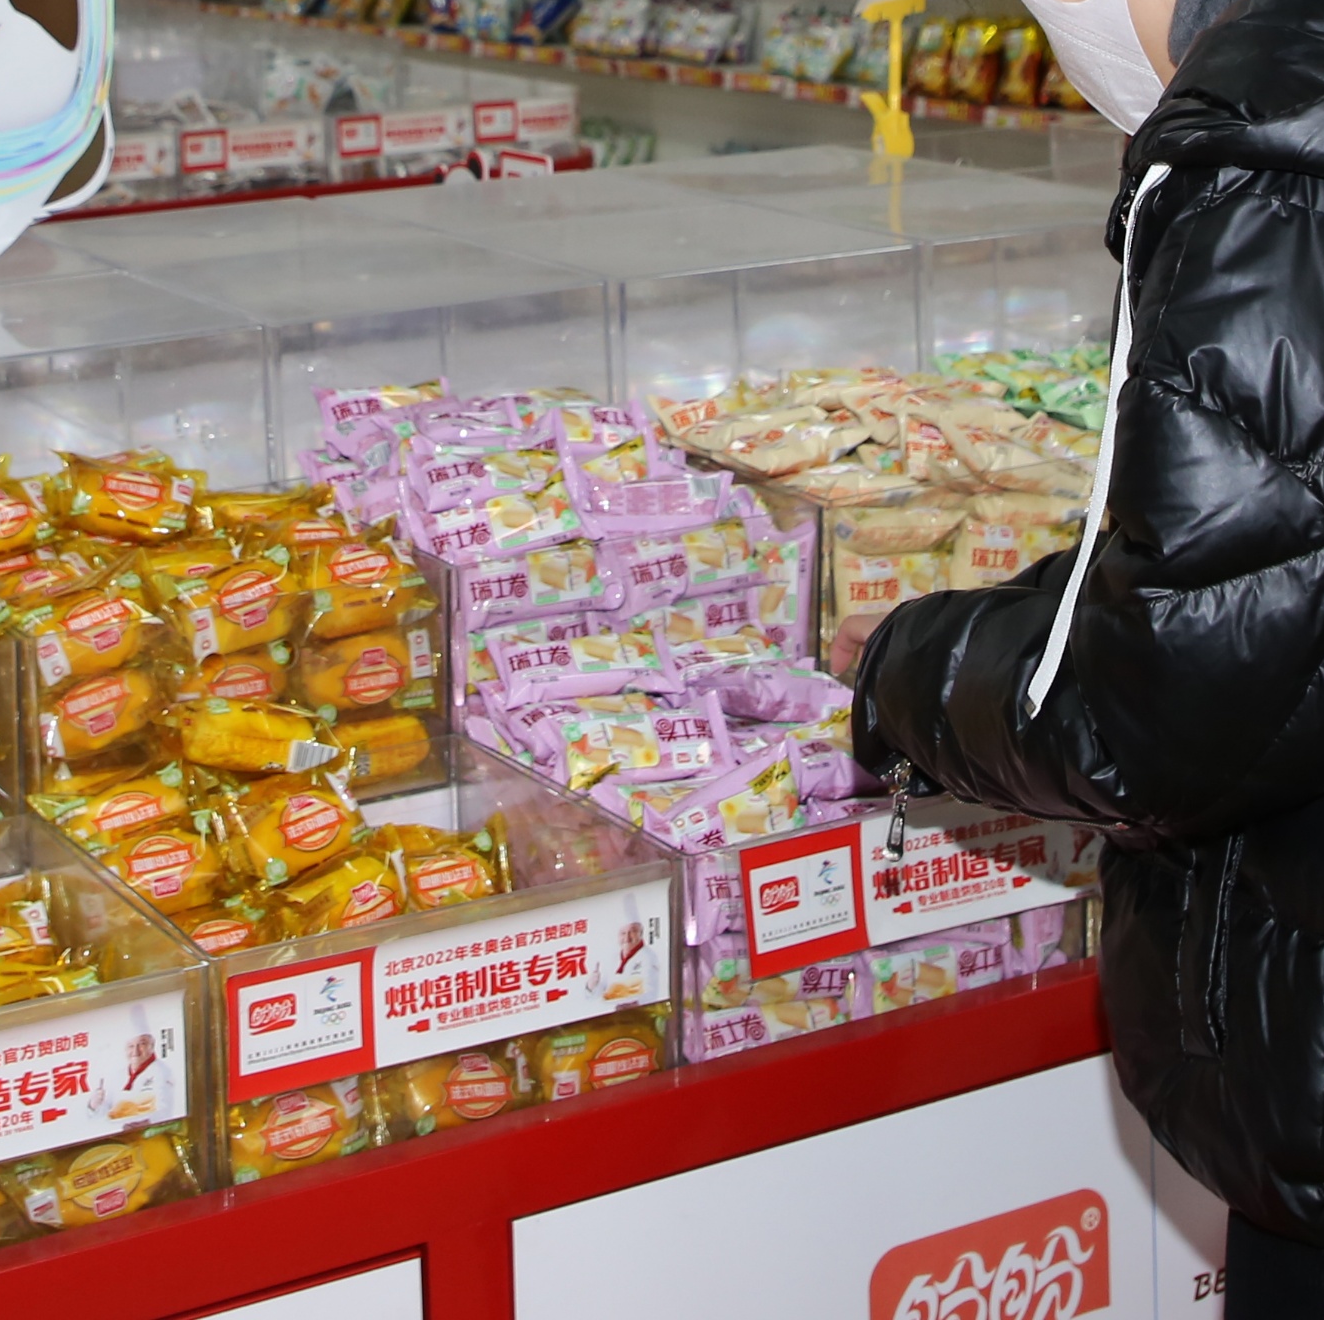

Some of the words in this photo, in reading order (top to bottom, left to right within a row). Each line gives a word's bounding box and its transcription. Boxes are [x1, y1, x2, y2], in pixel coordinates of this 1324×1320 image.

[427, 458, 486, 484] 瑞士卷
[432, 523, 491, 554] 瑞士卷
[630, 554, 688, 584] 瑞士卷
[470, 573, 529, 602] 瑞士卷
[508, 645, 571, 673] 瑞士卷
[873, 834, 1048, 902] 烘焙制造专家
[385, 918, 589, 977] 北京2022年冬奥会官方赞助商
[386, 945, 589, 1019] 烘焙制造专家
[436, 991, 541, 1024] 专业制造烘焙20年
